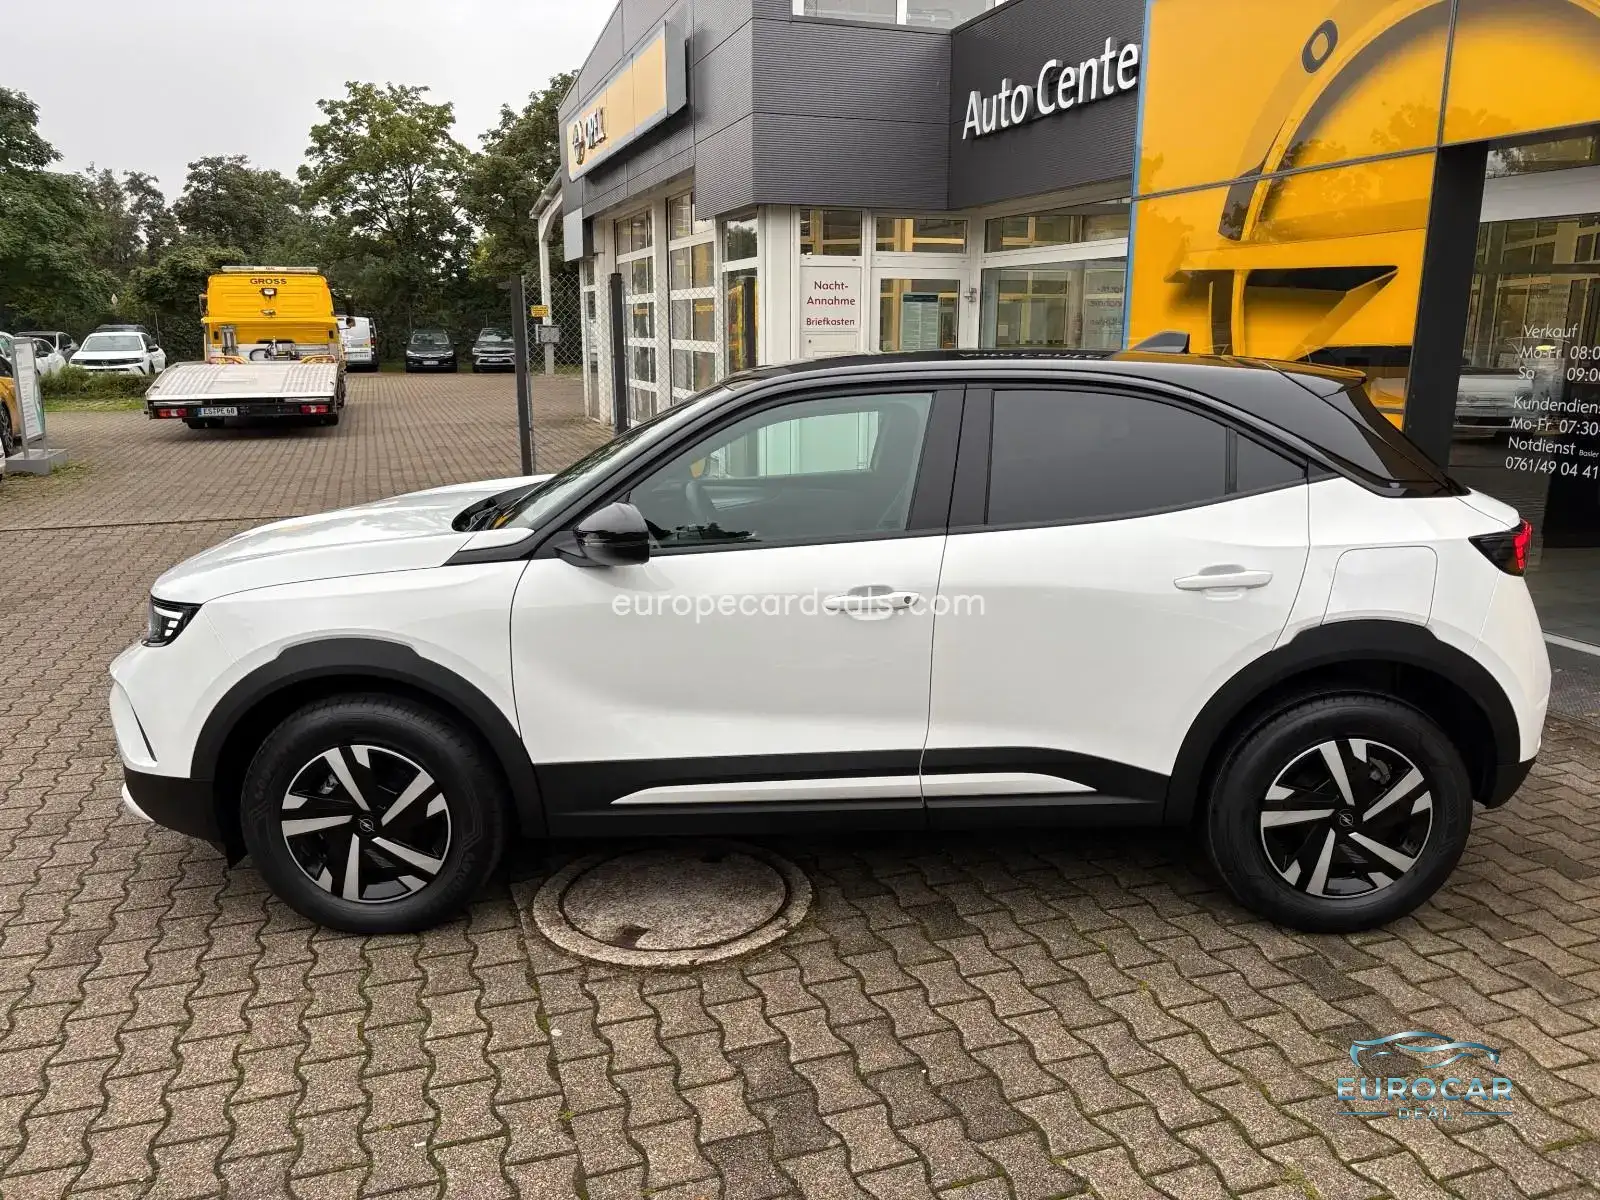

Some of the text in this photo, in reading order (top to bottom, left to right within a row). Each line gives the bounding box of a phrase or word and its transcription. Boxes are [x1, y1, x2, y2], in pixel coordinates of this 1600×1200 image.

[962, 36, 1139, 139] Auto Cente
[814, 280, 849, 290] Nacht-
[806, 295, 856, 306] Annahme
[806, 317, 855, 326] Briefkasten
[1523, 323, 1578, 338] Verkauf
[1520, 345, 1562, 359] Mo-Fr
[1518, 366, 1600, 382] Sa 09:0
[1510, 416, 1600, 436] Mo-Fr 07:30
[1508, 436, 1576, 455] Notdienst
[1505, 456, 1599, 479] 0761/49 04 41
